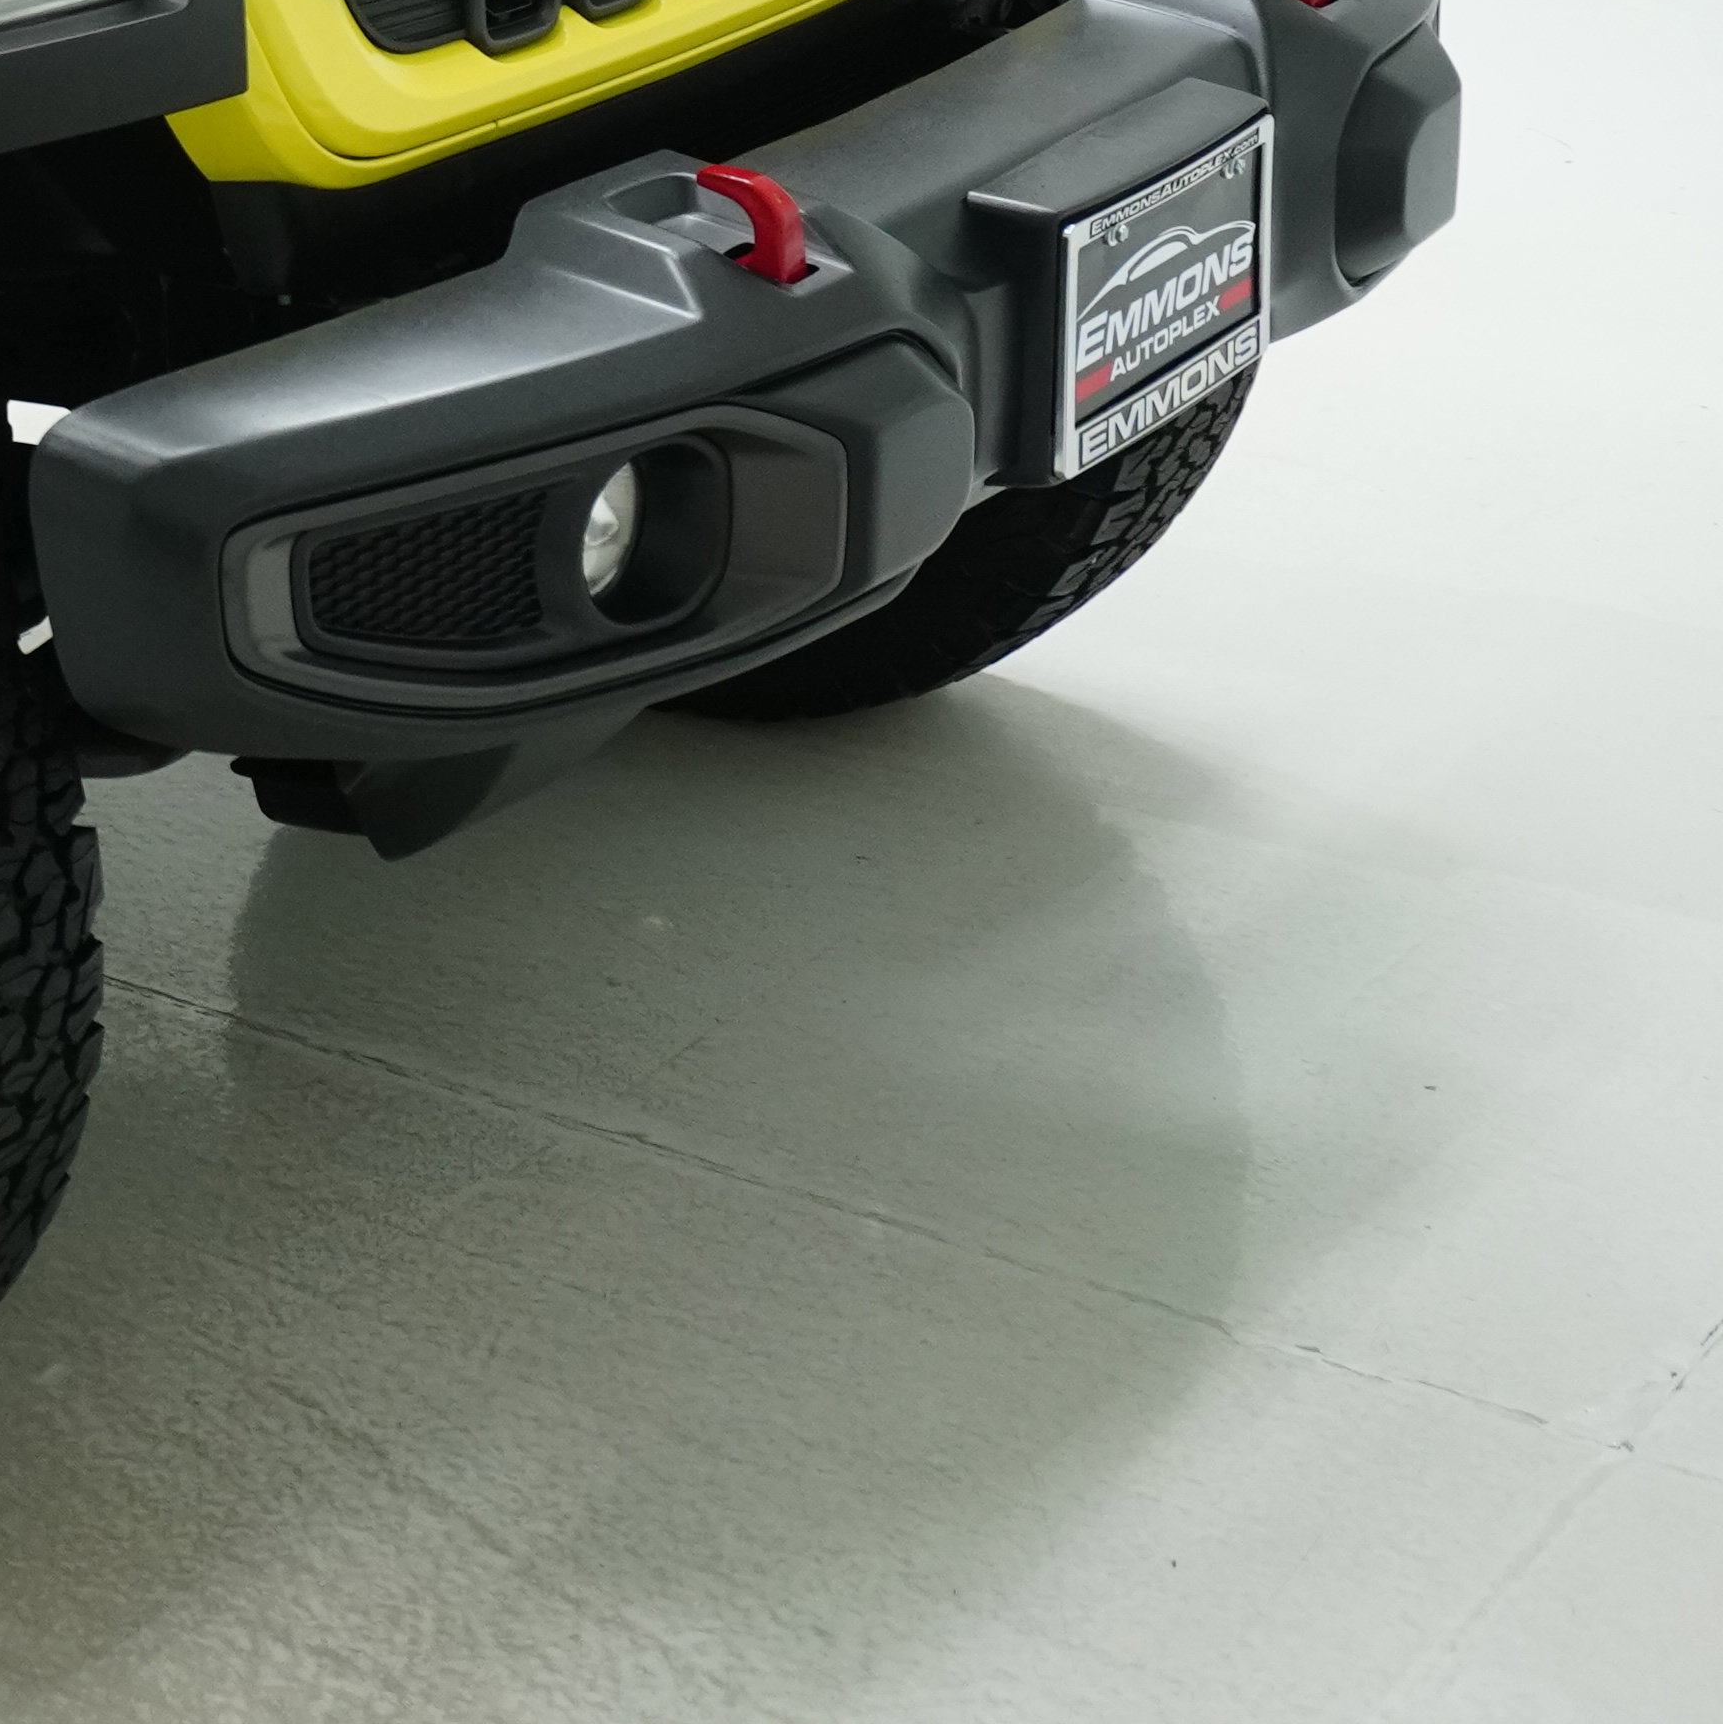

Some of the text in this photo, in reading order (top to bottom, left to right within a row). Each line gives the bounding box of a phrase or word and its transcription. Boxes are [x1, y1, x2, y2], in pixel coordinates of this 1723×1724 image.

[1092, 135, 1259, 235] EMMONSAUTOPLEX.com
[1079, 236, 1253, 370] EMMONS
[1111, 297, 1221, 381] AUTOPLEX
[1081, 331, 1258, 466] EMMONS
